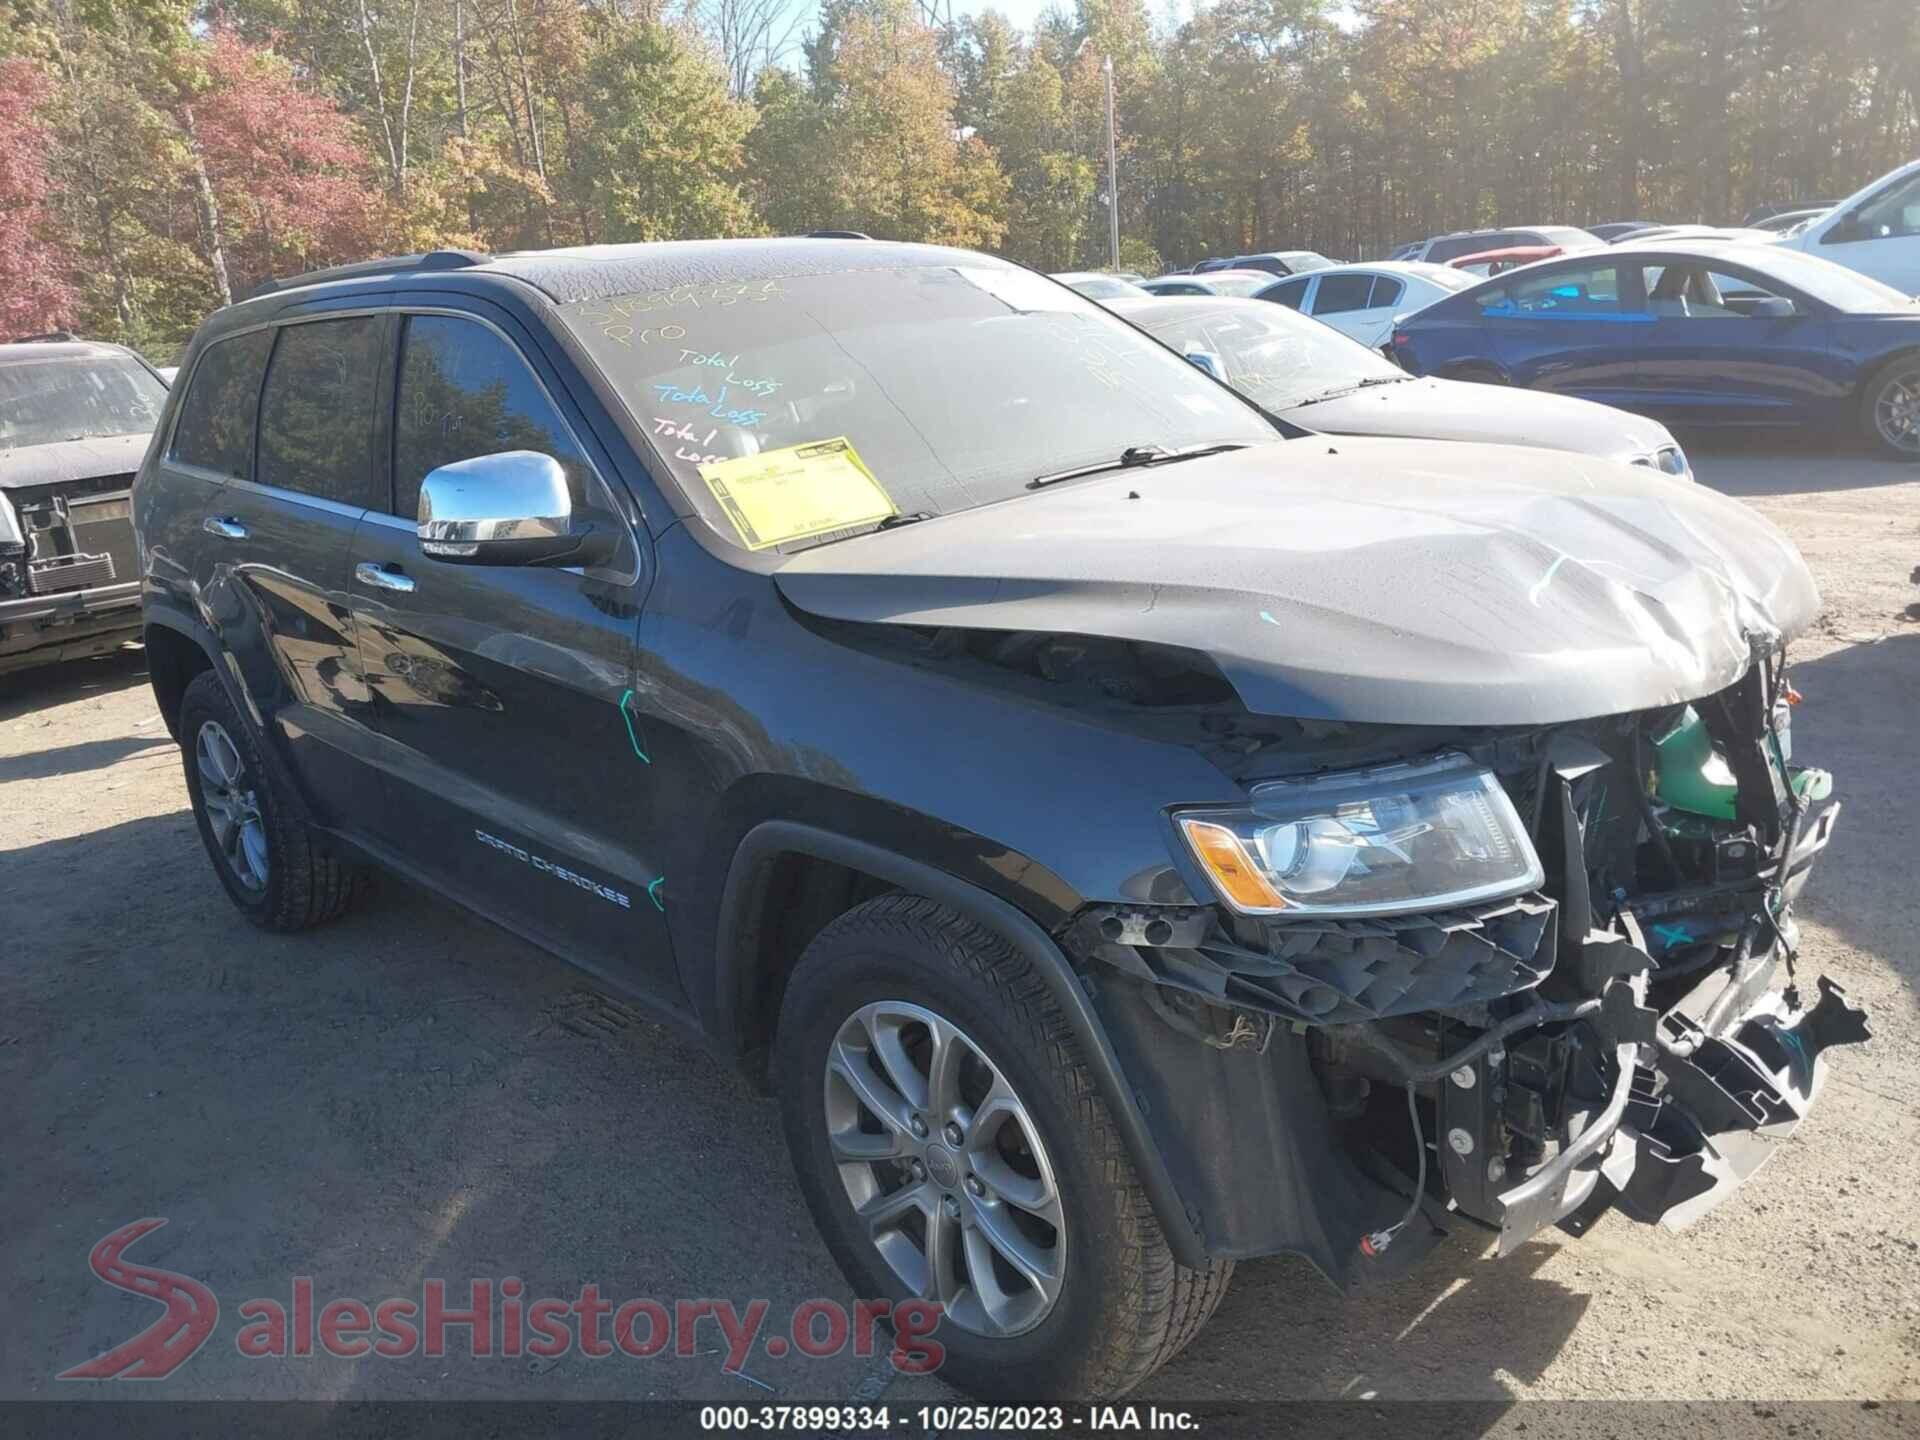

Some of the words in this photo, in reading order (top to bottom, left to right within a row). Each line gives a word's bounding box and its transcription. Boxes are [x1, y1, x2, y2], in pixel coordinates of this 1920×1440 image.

[679, 348, 739, 368] Total
[653, 384, 727, 404] Total
[725, 370, 783, 397] Loss
[709, 404, 768, 426] Loss
[653, 416, 718, 447] Total
[531, 854, 632, 909] CHEROKEE
